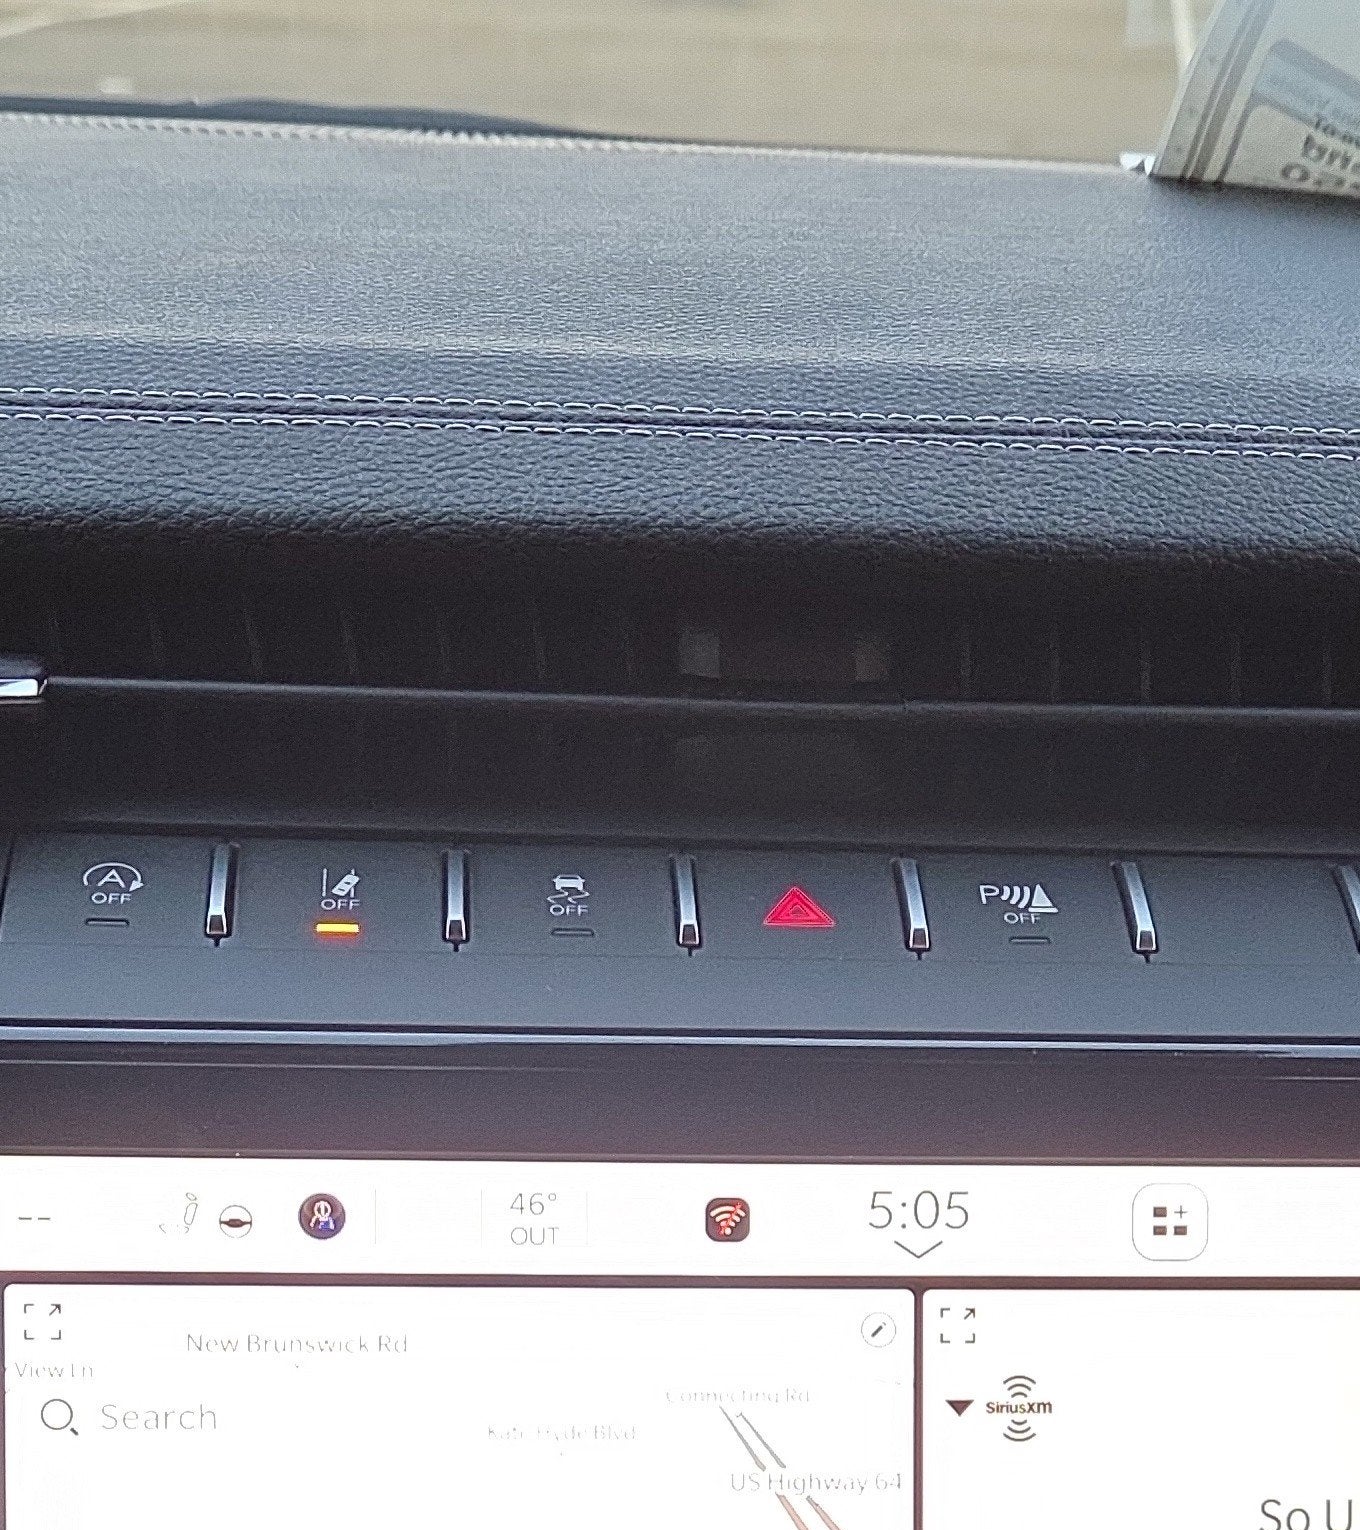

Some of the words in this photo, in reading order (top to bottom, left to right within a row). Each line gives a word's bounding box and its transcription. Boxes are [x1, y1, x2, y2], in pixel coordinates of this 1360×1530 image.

[91, 891, 132, 905] OFF
[320, 897, 361, 911] OFF
[549, 902, 589, 917] OFF
[1003, 911, 1041, 925] OFF
[510, 1192, 558, 1217] 46°
[867, 1190, 971, 1229] 5:05
[510, 1226, 560, 1246] OUT
[186, 1333, 239, 1354] New
[246, 1332, 370, 1354] Brunswick
[377, 1333, 409, 1354] Rd
[100, 1402, 218, 1431] Search
[729, 1472, 761, 1493] US
[767, 1471, 868, 1497] Highway
[874, 1472, 902, 1493] 64
